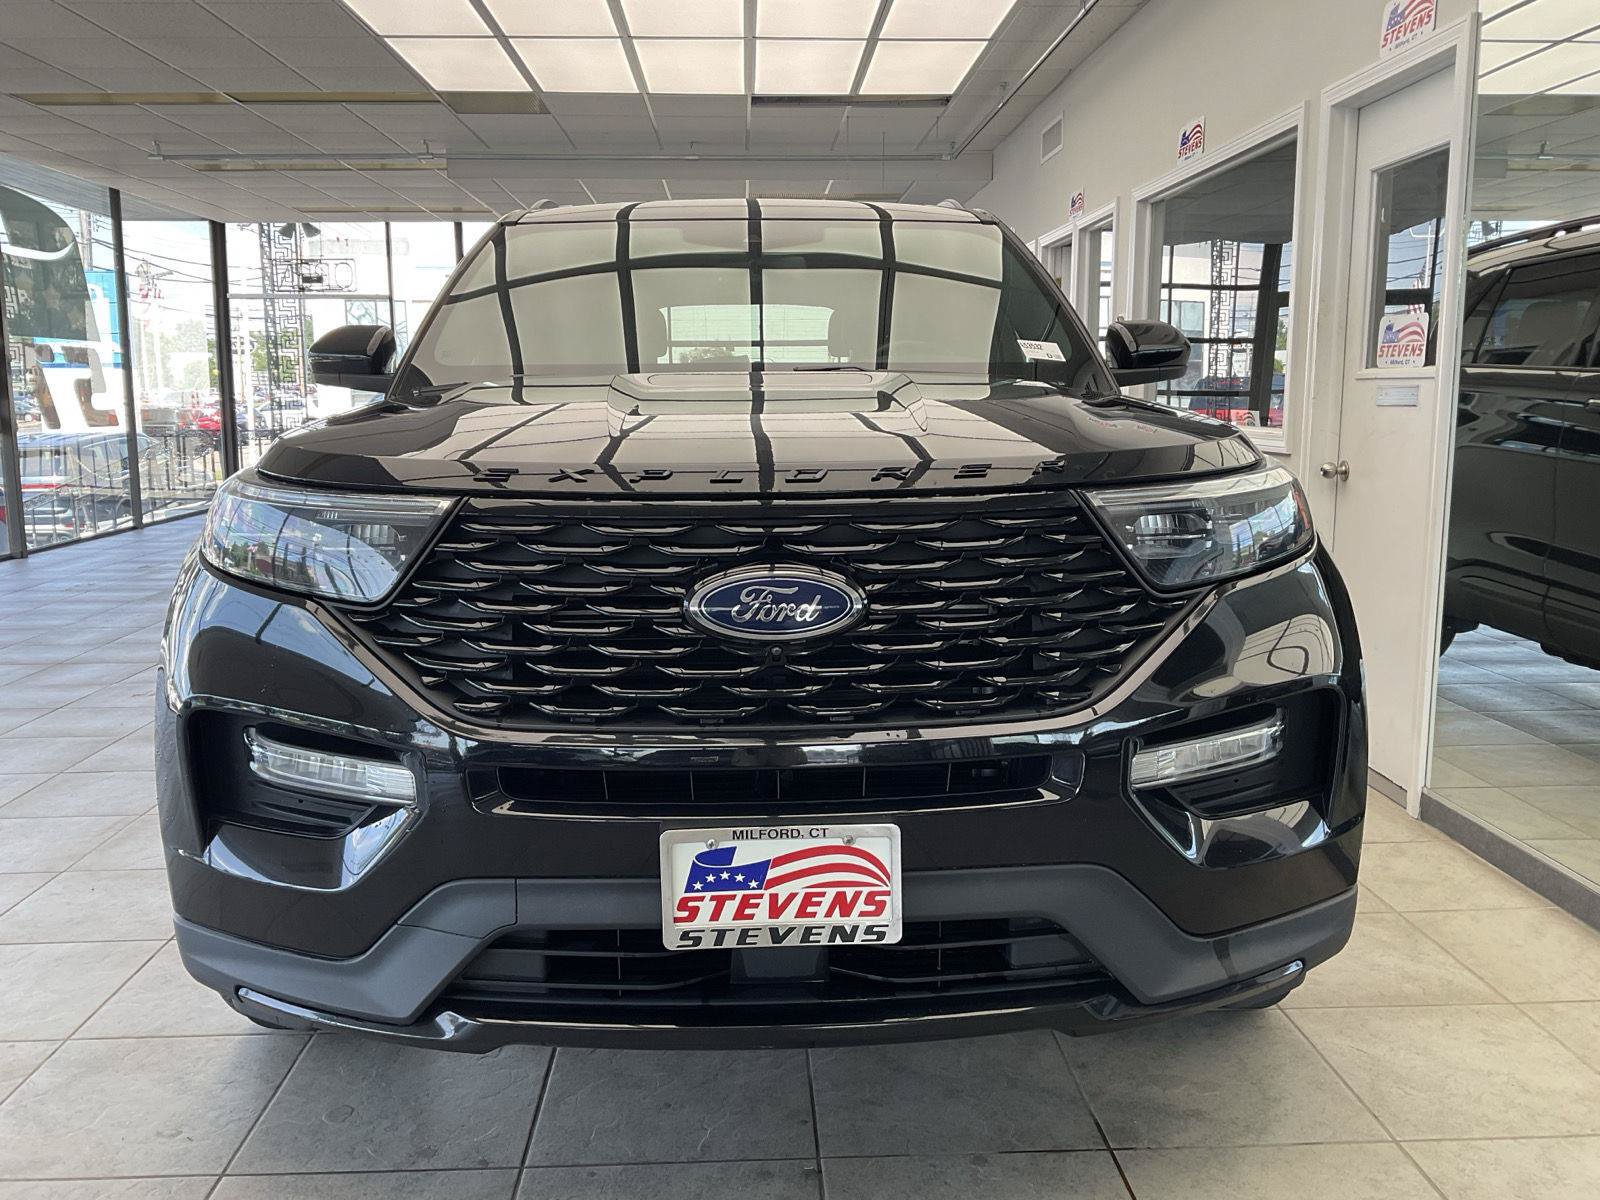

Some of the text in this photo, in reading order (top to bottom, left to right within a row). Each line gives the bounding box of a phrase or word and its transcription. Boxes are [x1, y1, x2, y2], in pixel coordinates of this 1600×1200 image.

[1382, 8, 1433, 48] STEVENS
[1178, 137, 1202, 159] STEVENS
[1378, 344, 1424, 357] STEVENS
[472, 459, 1067, 485] EXPLORER
[731, 585, 822, 623] Ford
[732, 827, 829, 840] MILFORD, CT
[674, 890, 891, 924] STEVENS
[676, 924, 890, 949] STEVENS
